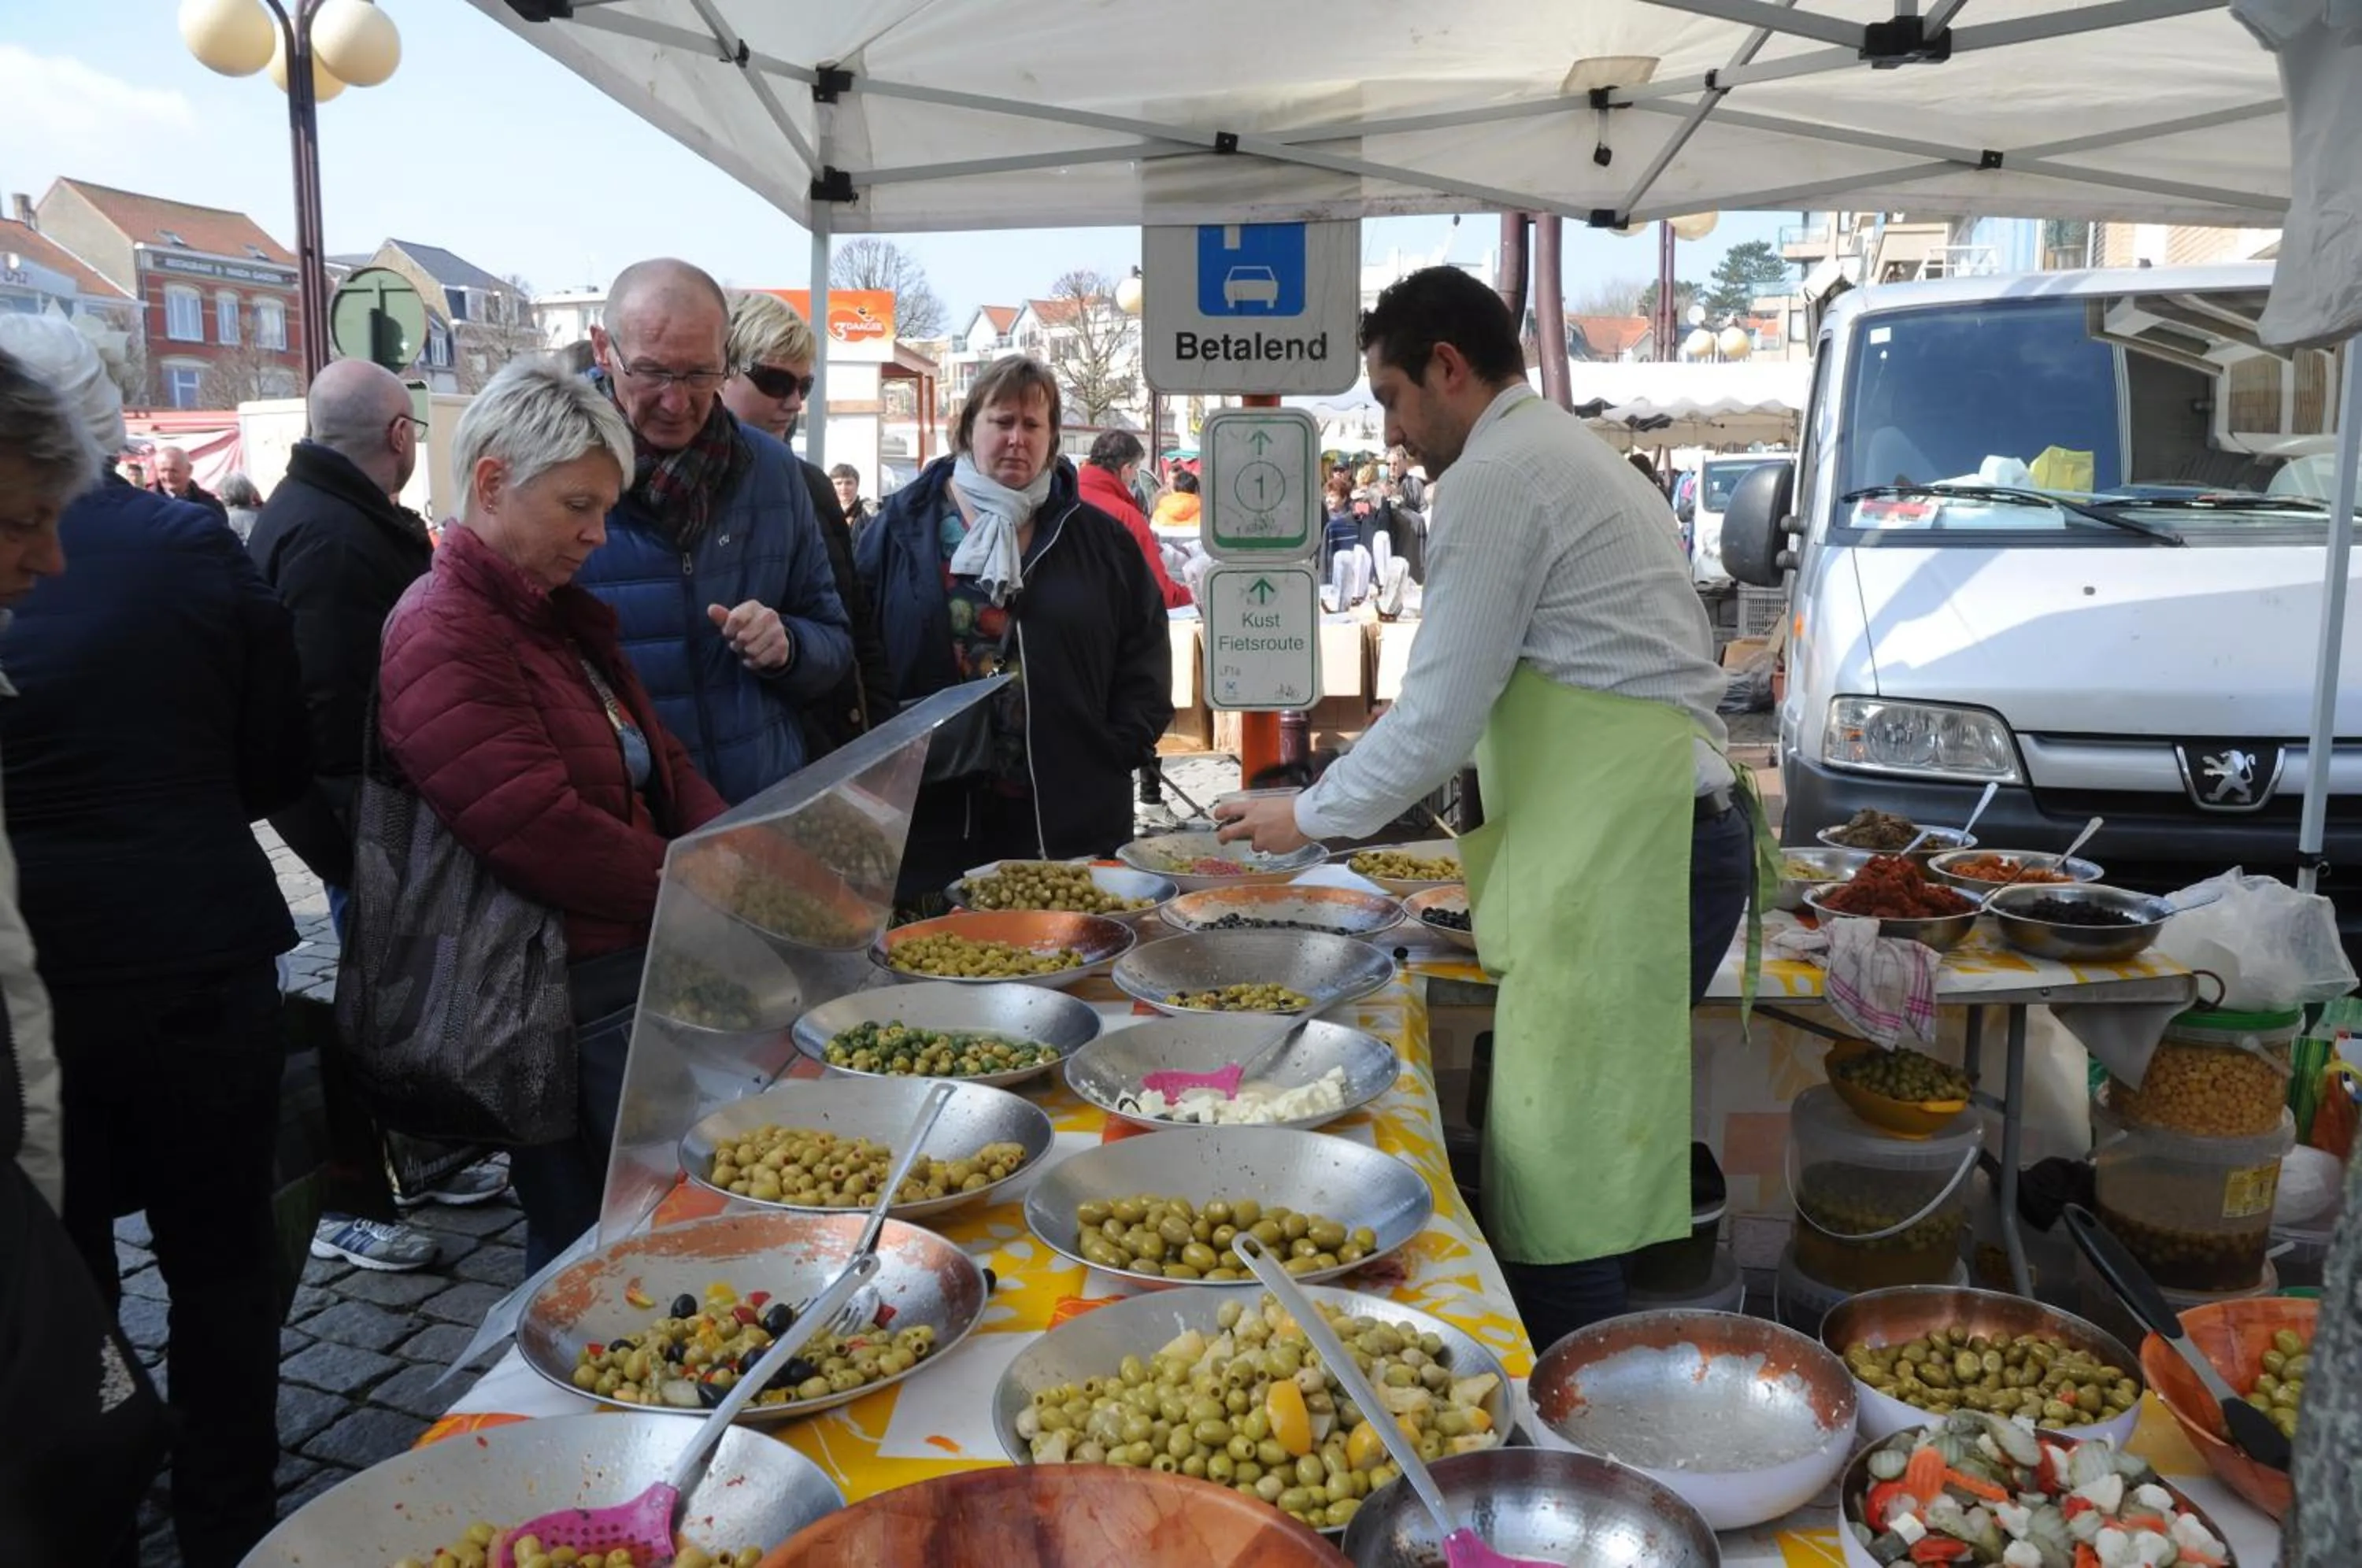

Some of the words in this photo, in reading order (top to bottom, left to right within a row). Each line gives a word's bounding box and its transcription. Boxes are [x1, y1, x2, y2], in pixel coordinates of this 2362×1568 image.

[1175, 331, 1328, 361] Betalend
[1254, 473, 1264, 501] 1
[1242, 612, 1280, 627] Kust
[1218, 634, 1305, 652] Fietsroute
